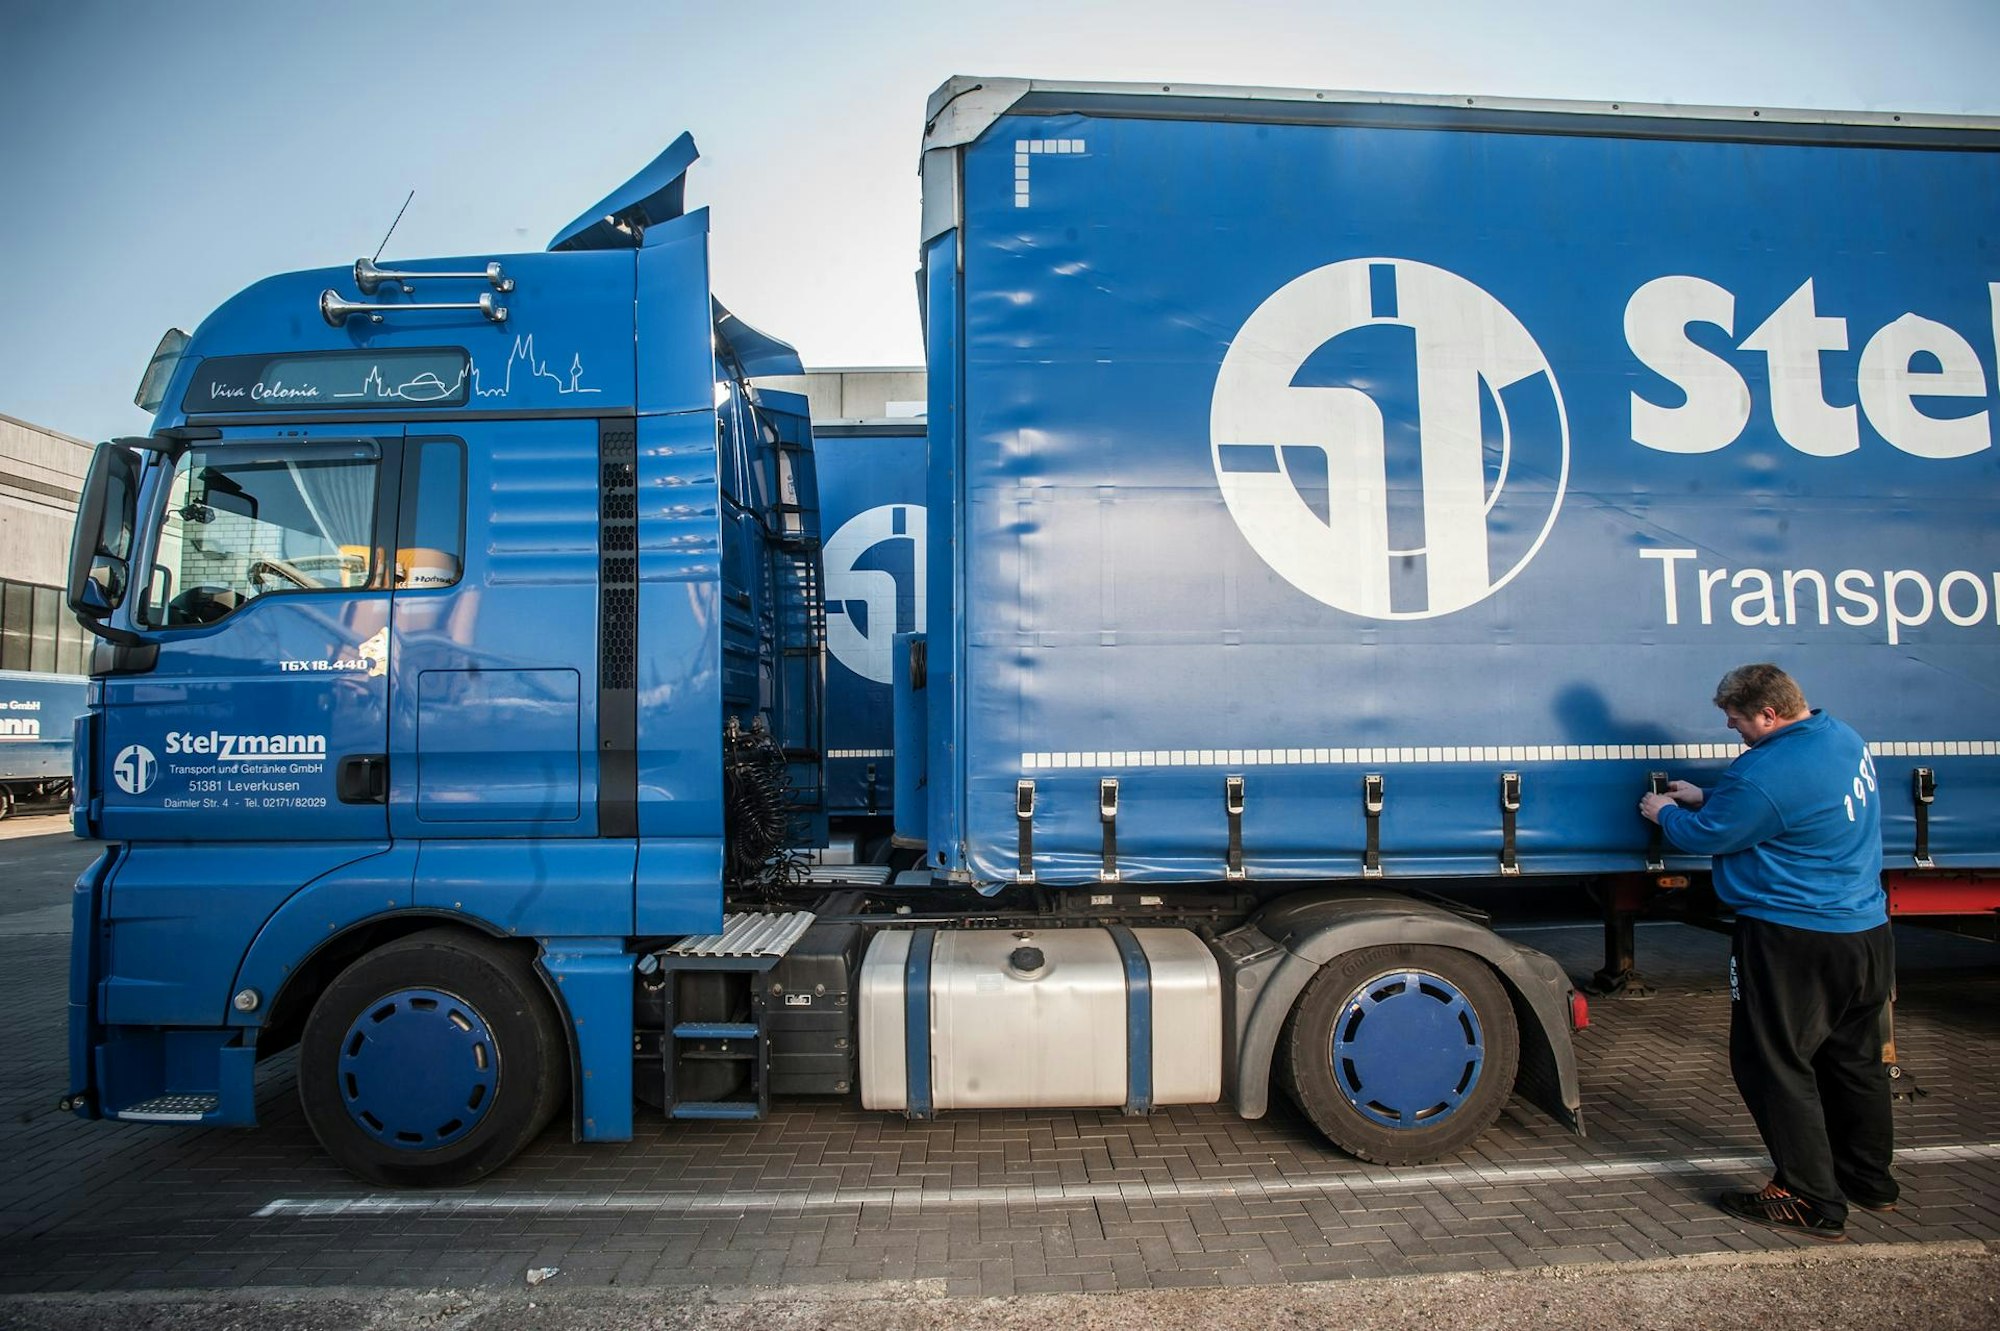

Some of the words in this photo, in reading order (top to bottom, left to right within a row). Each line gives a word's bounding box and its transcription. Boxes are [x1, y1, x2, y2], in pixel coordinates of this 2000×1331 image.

[1623, 274, 2000, 459] Ste
[211, 381, 245, 399] Viva
[251, 380, 319, 400] Colonia
[280, 660, 309, 671] TGX
[311, 659, 368, 671] 18.440
[9, 700, 41, 710] GmbH
[165, 731, 326, 760] Stelzmann
[169, 764, 216, 775] Transport
[218, 764, 238, 774] und
[240, 764, 287, 774] Getränke
[289, 763, 323, 773] GmbH
[189, 780, 222, 792] 51381
[227, 780, 300, 792] Leverkusen
[164, 798, 200, 808] Daimler
[203, 798, 220, 808] Str.
[222, 799, 228, 808] 4
[244, 798, 260, 808] Tel.
[262, 797, 326, 808] 02171/82029
